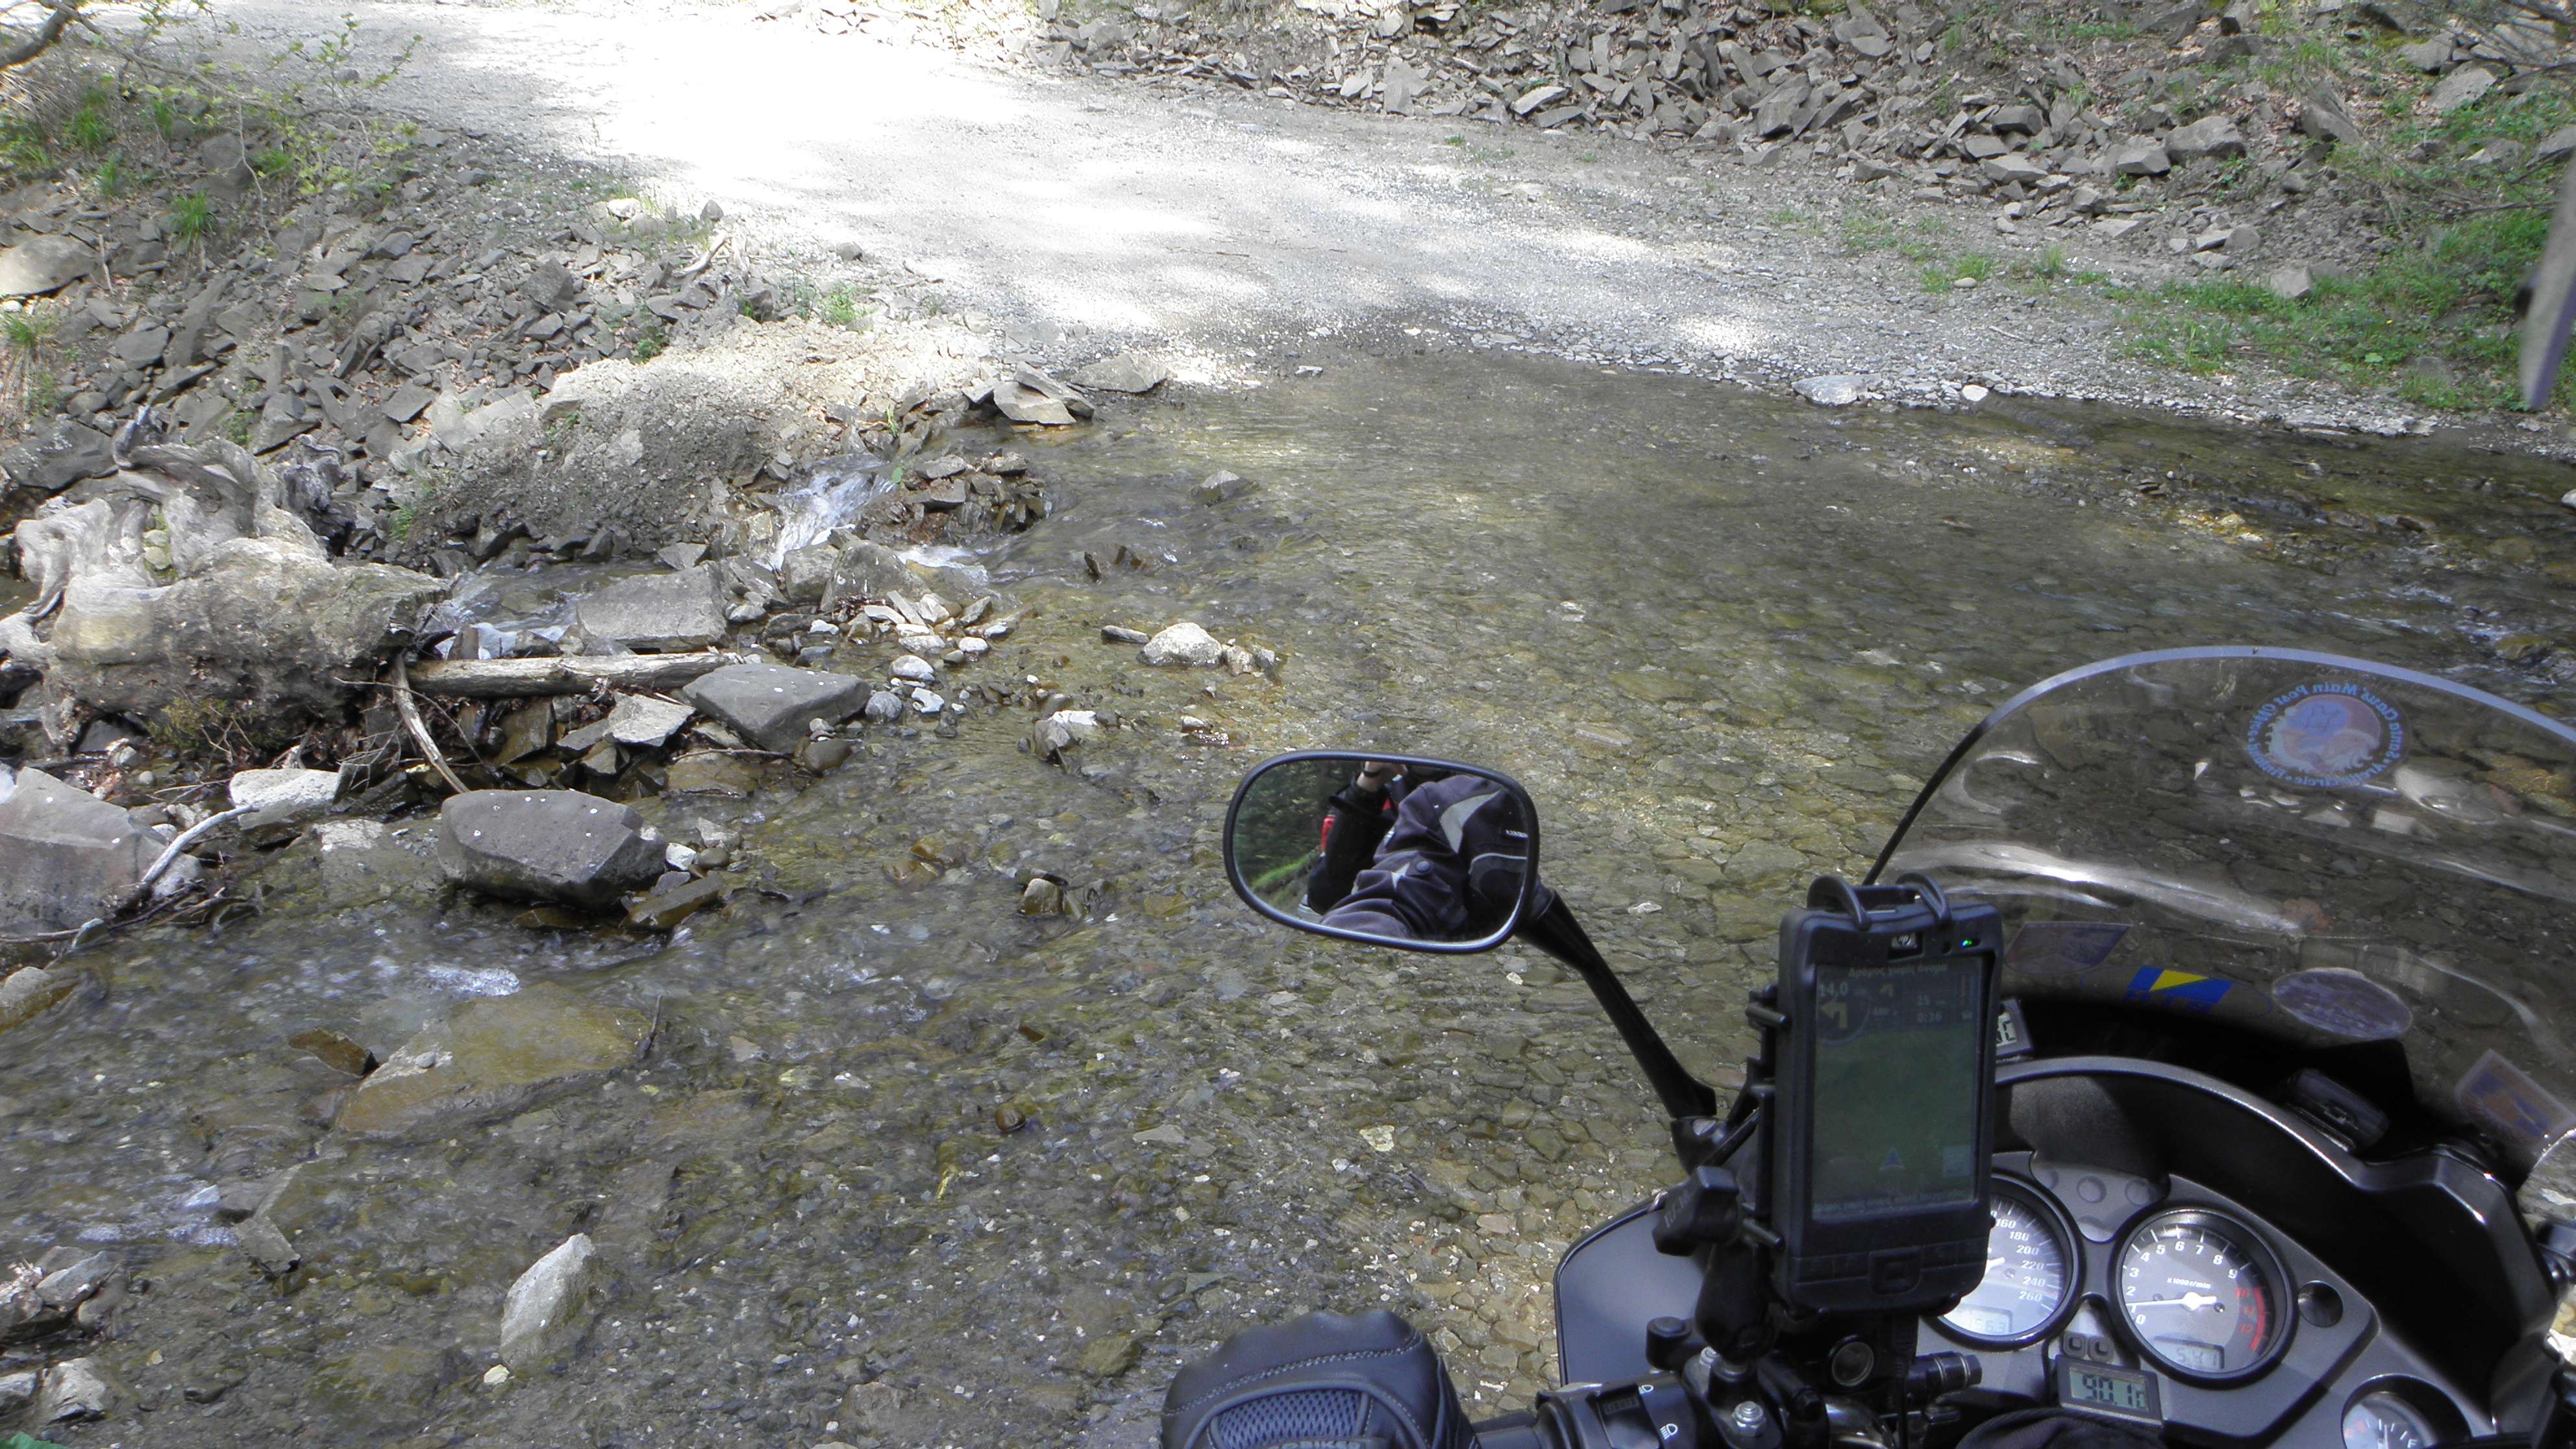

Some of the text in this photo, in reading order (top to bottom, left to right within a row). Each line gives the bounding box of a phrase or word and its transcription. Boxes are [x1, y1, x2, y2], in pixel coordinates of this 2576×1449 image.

[1995, 1219, 2016, 1229] 160
[2009, 1231, 2030, 1241] 180
[2016, 1245, 2039, 1256] 200
[2156, 1245, 2166, 1254] 5
[2175, 1241, 2185, 1251] 6
[2196, 1245, 2204, 1254] 7
[2140, 1252, 2150, 1262] 4
[2213, 1255, 2223, 1265] 8
[2020, 1260, 2044, 1270] 220
[2129, 1267, 2140, 1278] 3
[2228, 1269, 2238, 1279] 9
[2022, 1276, 2046, 1287] 240
[2125, 1286, 2136, 1296] 2
[2018, 1291, 2043, 1302] 260
[2135, 1314, 2146, 1325] 0
[2407, 1438, 2418, 1448] F
